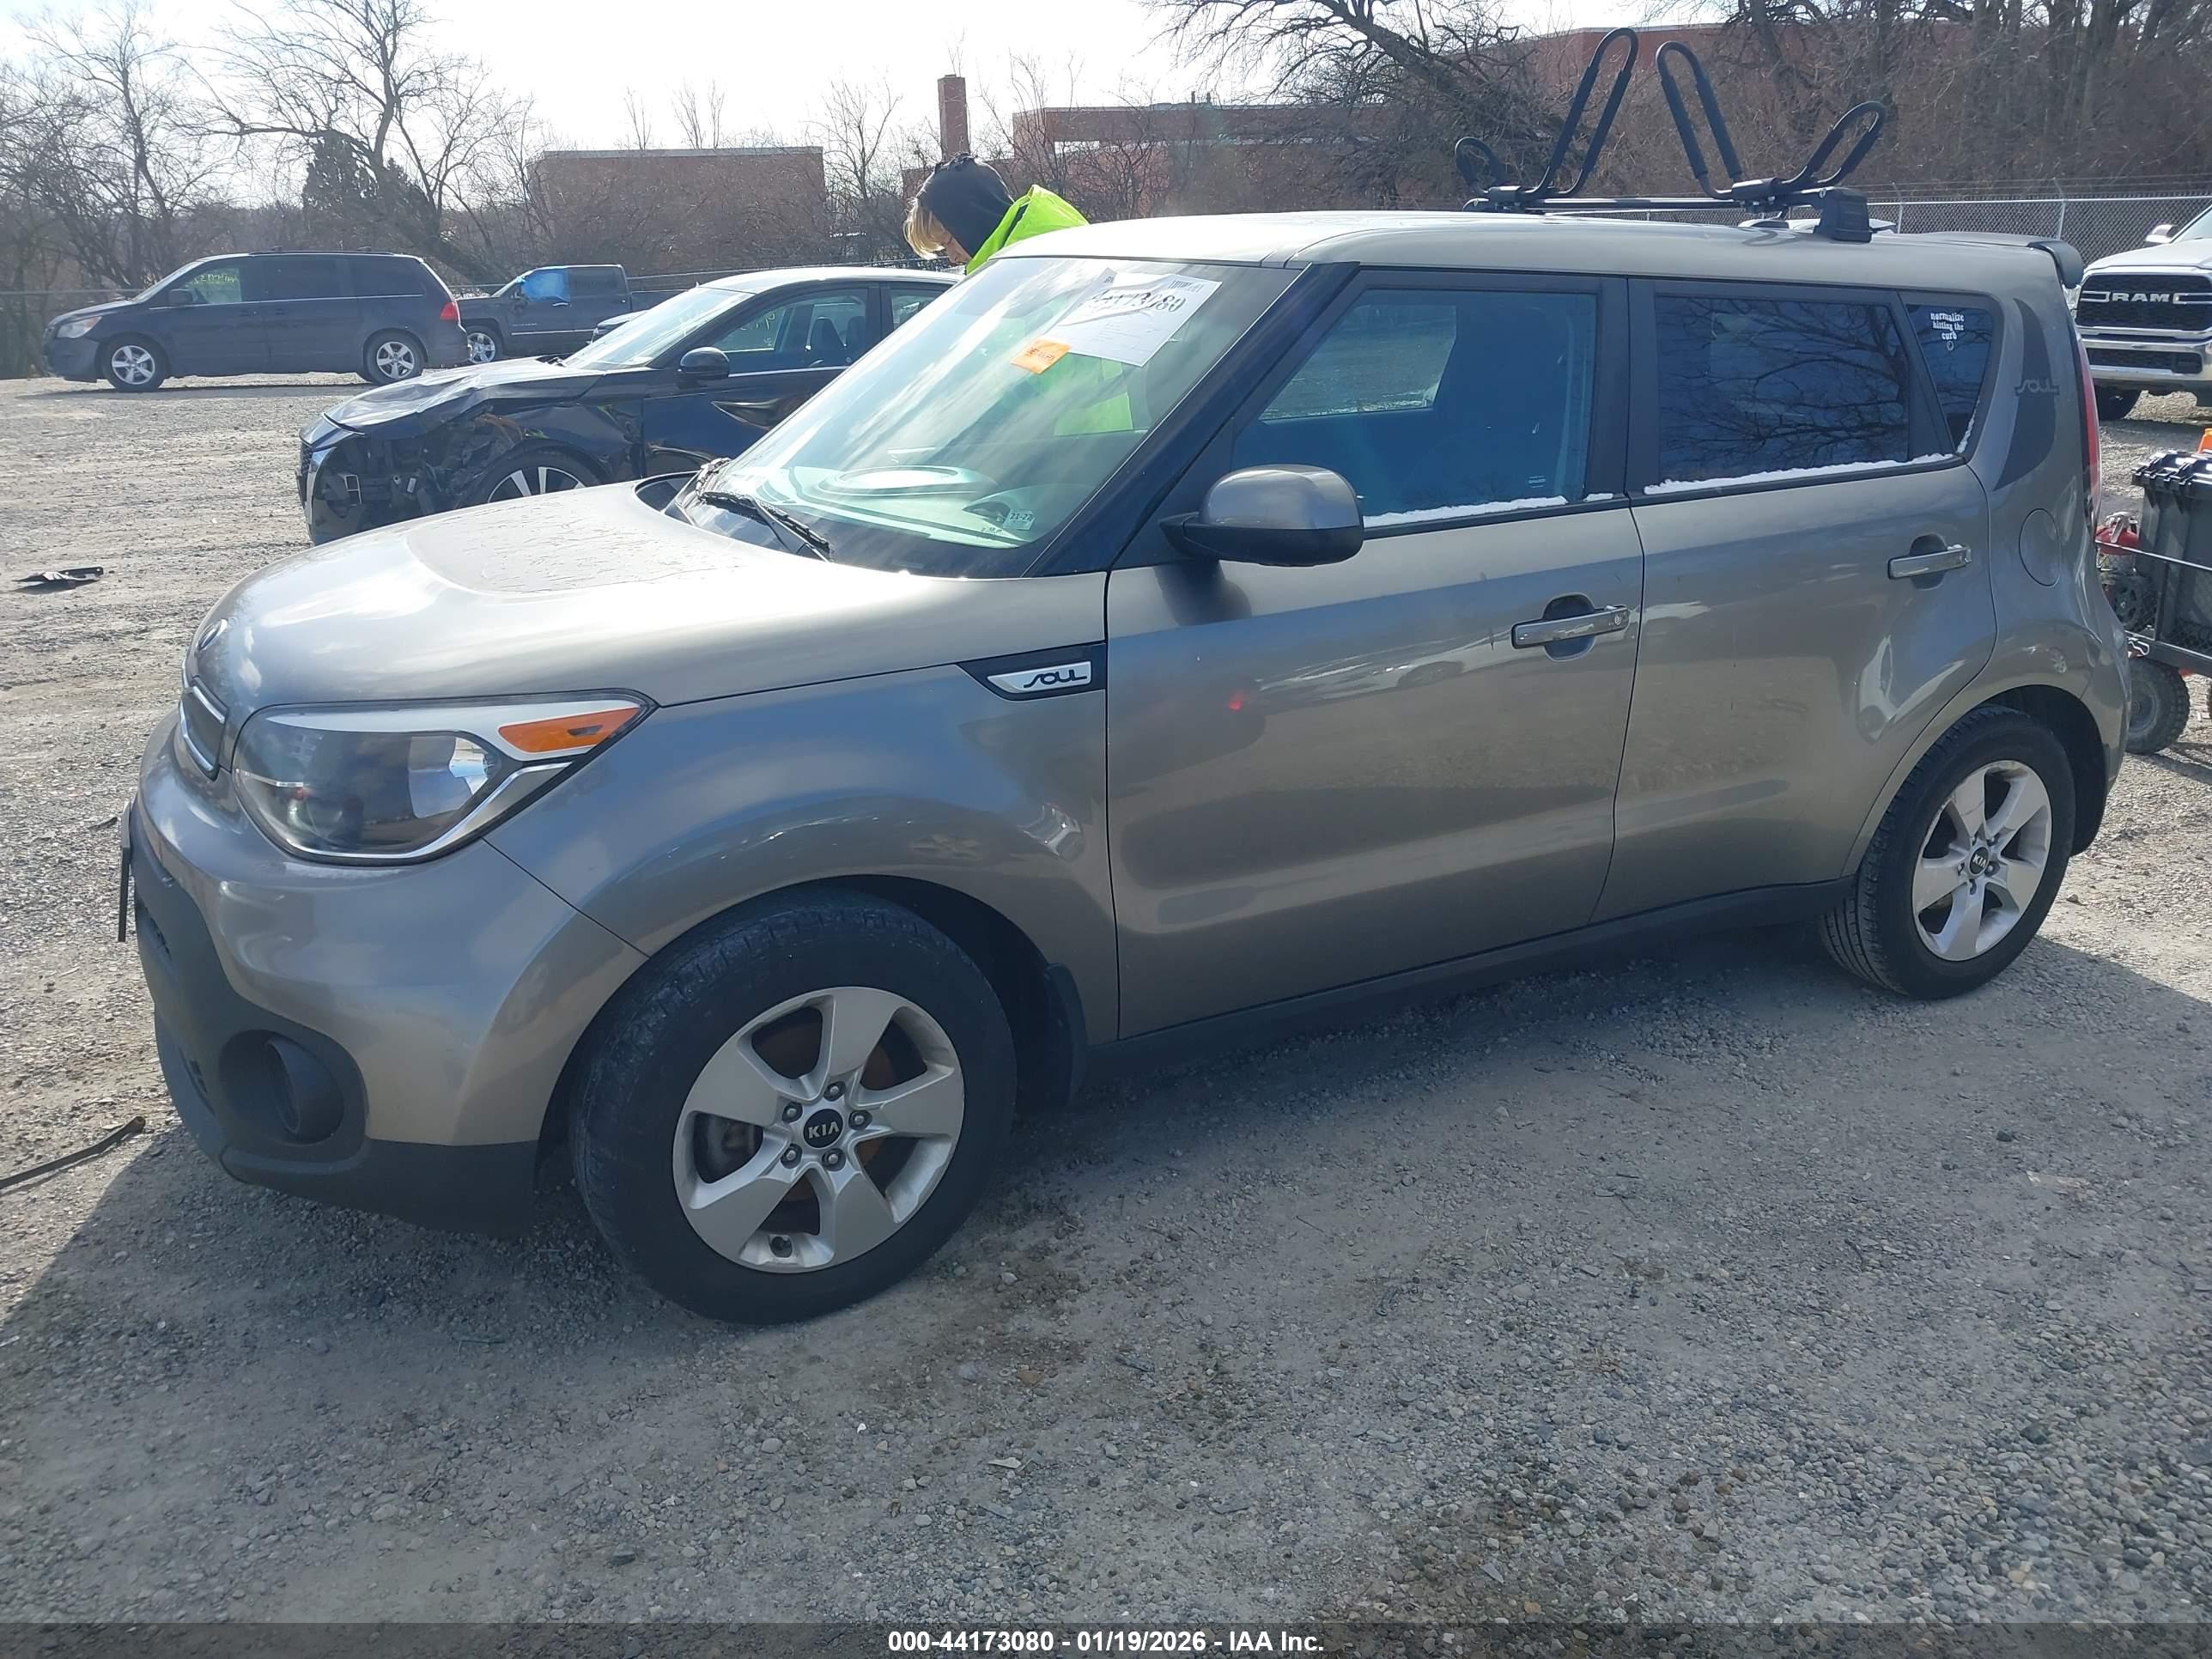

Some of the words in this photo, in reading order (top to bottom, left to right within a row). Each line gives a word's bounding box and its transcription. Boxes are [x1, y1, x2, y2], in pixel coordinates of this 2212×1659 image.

[2112, 293, 2171, 302] RAM
[1929, 313, 1965, 322] normalize
[1932, 320, 1953, 332] hitting
[1954, 321, 1965, 331] the
[1941, 331, 1958, 340] curb
[1023, 669, 1088, 689] SOUL
[1972, 854, 1987, 868] KIA
[808, 1121, 840, 1139] KIA
